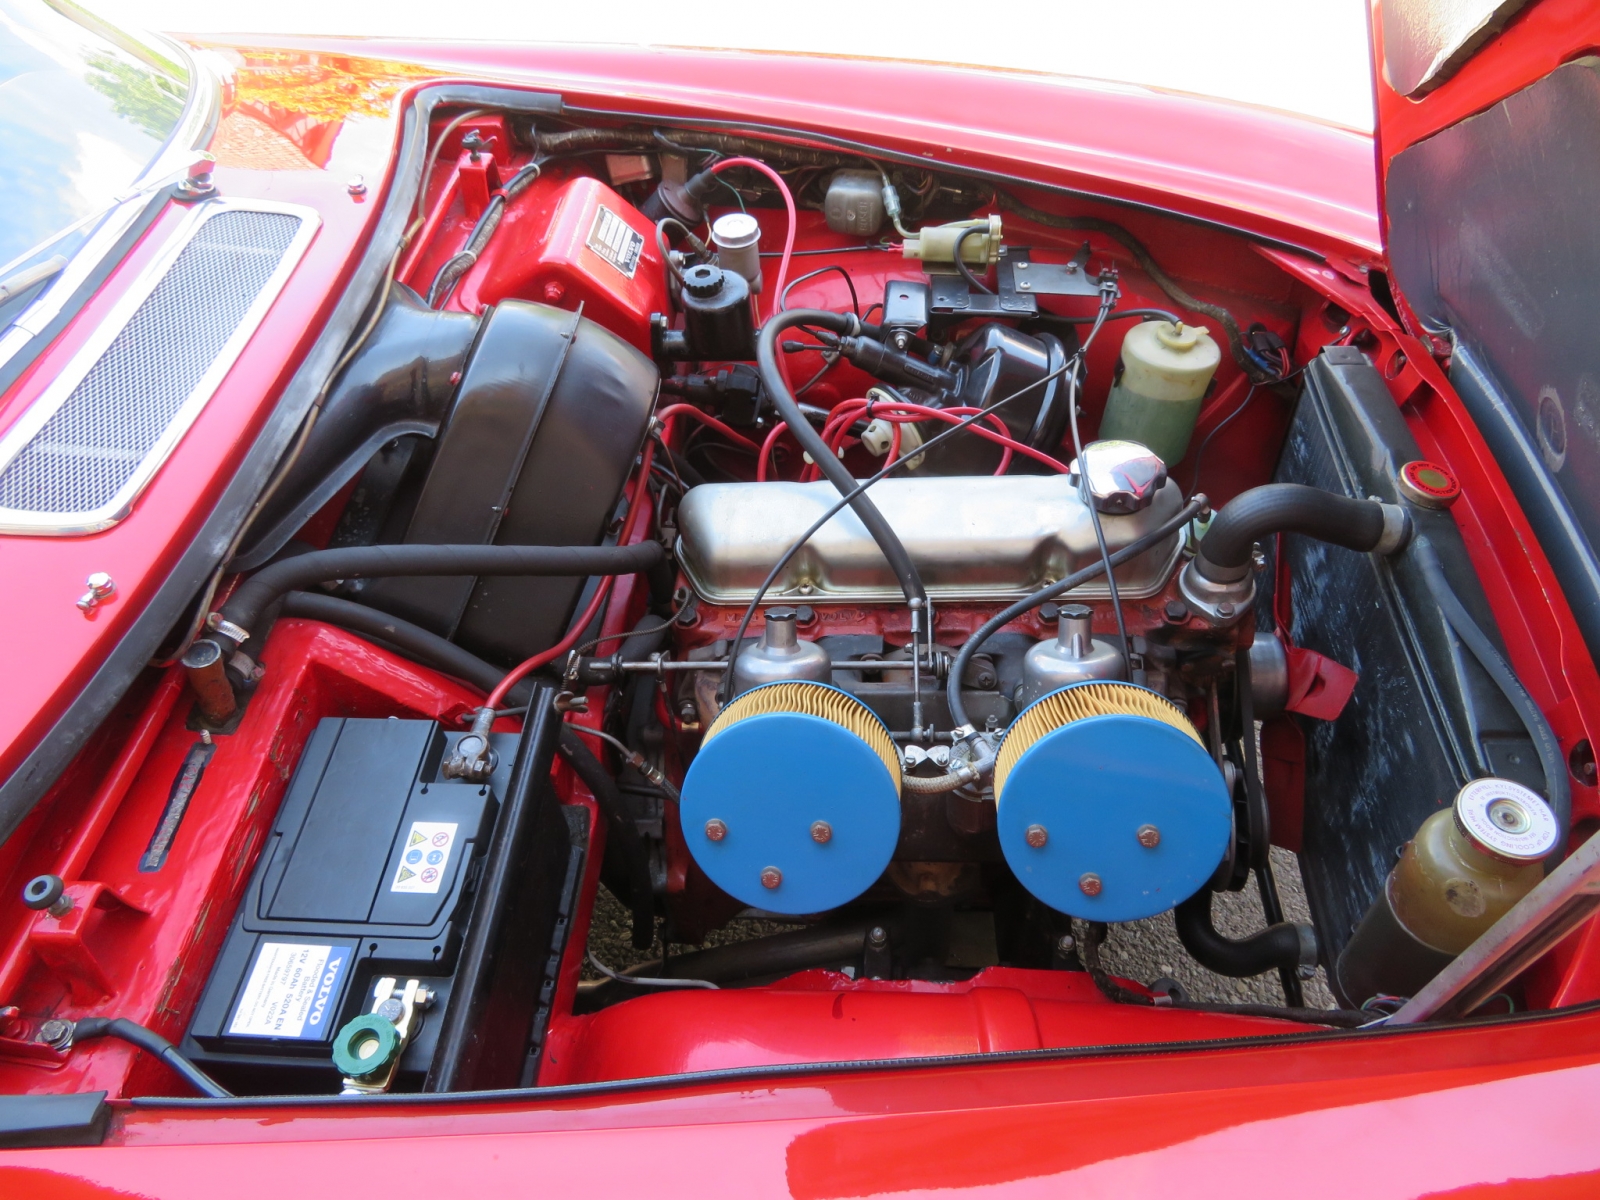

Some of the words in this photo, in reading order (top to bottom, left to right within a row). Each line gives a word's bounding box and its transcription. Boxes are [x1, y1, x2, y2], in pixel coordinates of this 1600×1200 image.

[624, 241, 636, 263] VOLVO
[819, 612, 866, 623] VOLVO
[1475, 824, 1497, 842] SYSTEM
[1500, 841, 1535, 850] COOLING
[299, 949, 309, 964] 12V
[289, 968, 302, 989] 60Ah
[309, 959, 324, 987] Flooded
[295, 976, 311, 1002] Battery
[309, 957, 342, 1025] VOLVO
[280, 994, 293, 1016] 520A
[297, 996, 311, 1021] Sealed
[274, 1018, 284, 1030] EN
